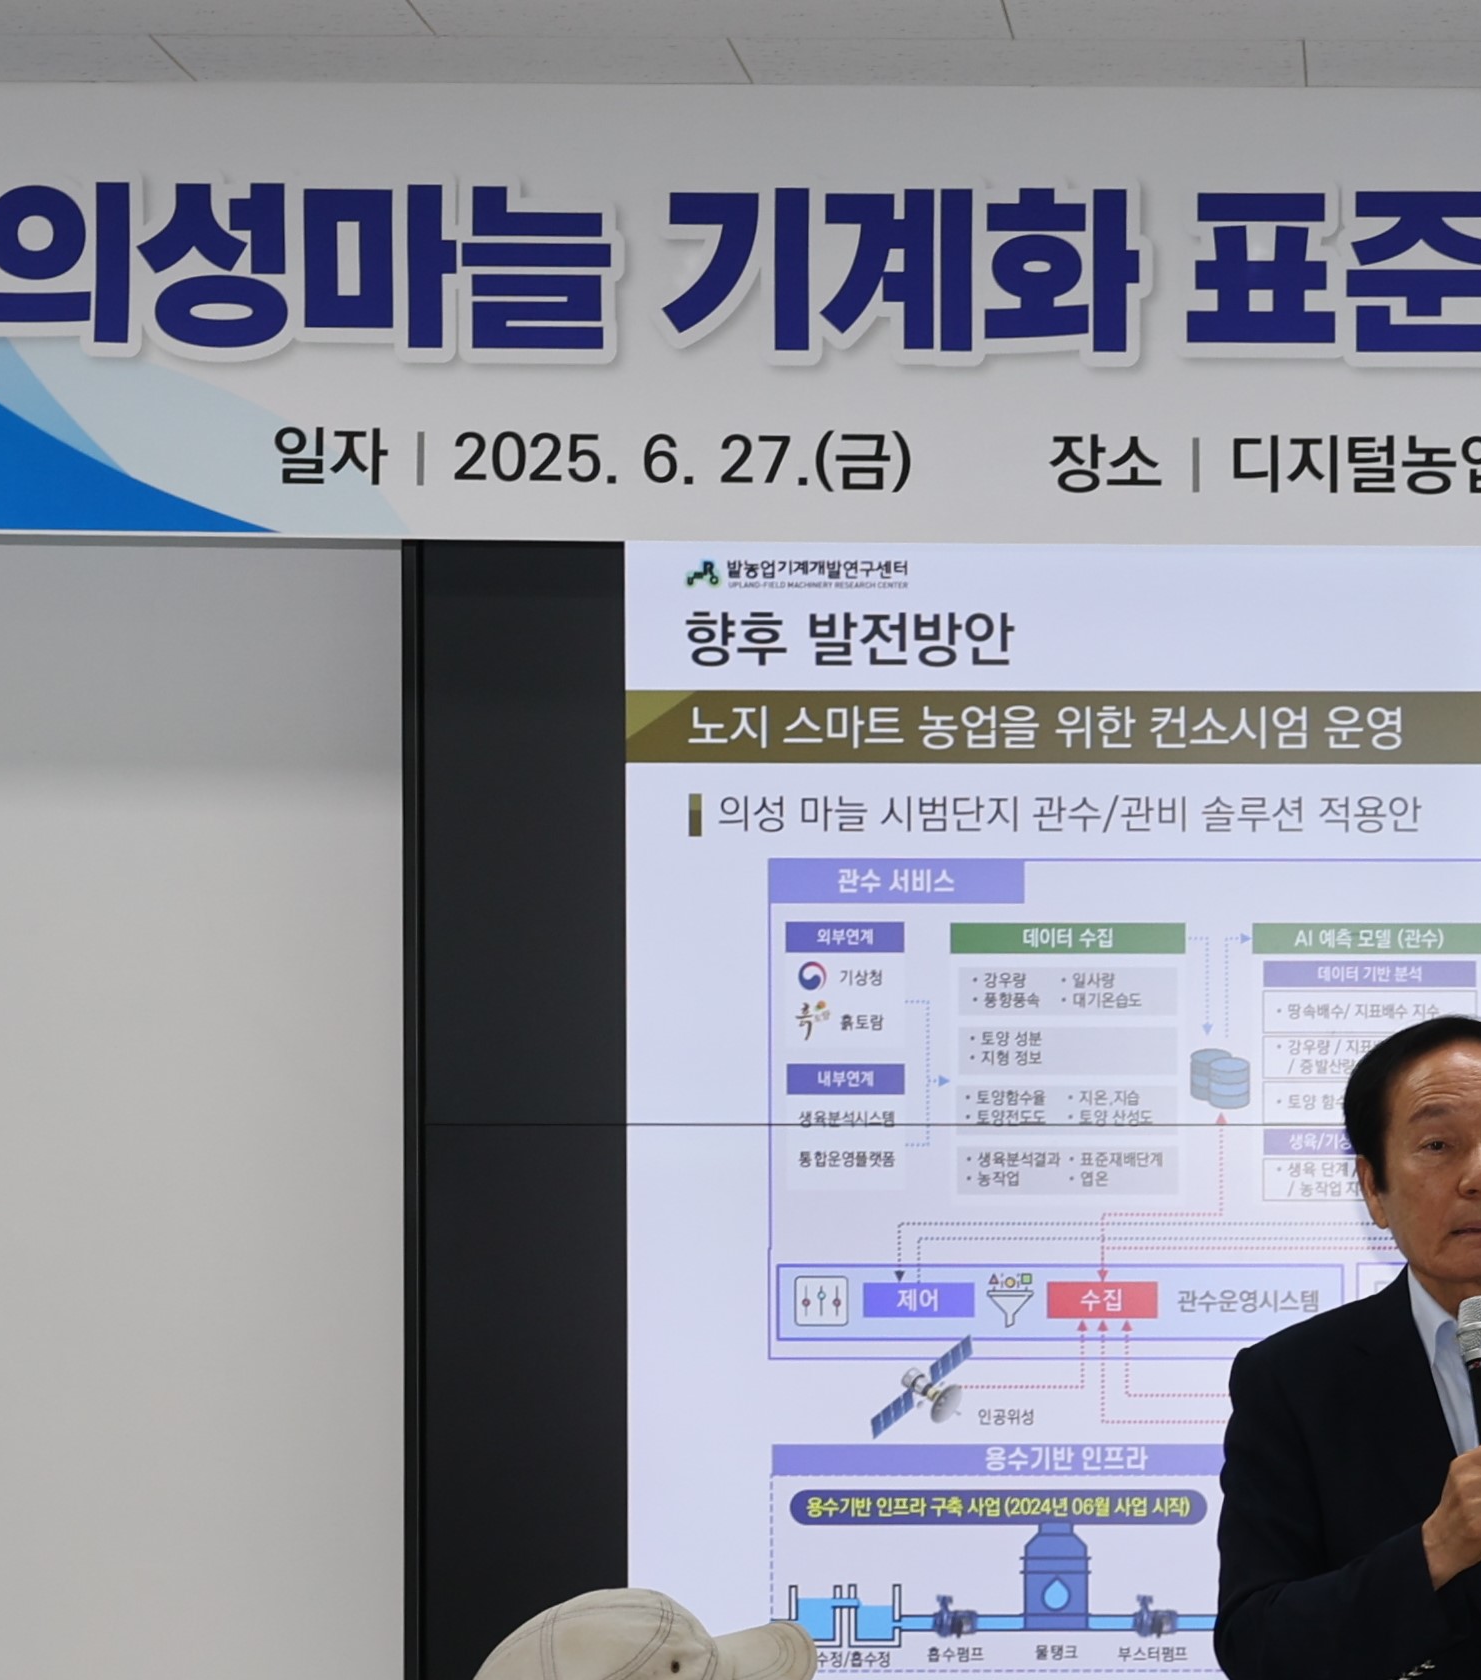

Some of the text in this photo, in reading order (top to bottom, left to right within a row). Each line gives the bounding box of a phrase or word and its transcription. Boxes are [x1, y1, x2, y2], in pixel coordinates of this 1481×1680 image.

[662, 184, 1139, 355] 기계화
[274, 424, 912, 495] 일자 2025. 6. 27.(금)
[1048, 428, 1163, 494] 장소
[727, 560, 908, 579] 밭농업기계개발연구센터
[686, 612, 1015, 667] 향후 발전방안
[688, 704, 1404, 750] 노지 스마트 농업을 위한 컨소시엄 운영
[718, 794, 1420, 834] 의성 마늘 시범단지 관수/관비 솔루션 적용안
[838, 868, 955, 894] 관수 서비스
[817, 928, 873, 946] 외부연계
[1023, 928, 1113, 948] 데이터 수집
[1295, 928, 1444, 950] AI 예측 모델 (관수)
[840, 970, 882, 986] 기상청
[984, 973, 1115, 988] 강우량 일사량
[1318, 966, 1422, 982] 데이터 기반 분석
[1355, 1004, 1407, 1019] 지표배수
[981, 1031, 1042, 1046] 토양 성분
[1288, 1040, 1330, 1054] 강우량
[981, 1051, 1042, 1066] 지형 정보
[818, 1070, 874, 1087] 내부연계
[1288, 1095, 1316, 1110] 토양
[799, 1151, 895, 1168] 통합운영플랫폼
[978, 1151, 1163, 1168] 생육분석결과 표준재배단계
[978, 1171, 1019, 1187] 농작업
[896, 1290, 939, 1311] 제어
[1080, 1289, 1122, 1312] 수집
[1178, 1290, 1319, 1313] 관수운영시스템
[978, 1409, 1034, 1426] 인공위성
[985, 1446, 1148, 1472] 용수기반 인프라
[806, 1497, 1190, 1517] 용수기반 인프라 구축 사업 (2024년 06월 사업 시작)
[817, 1650, 890, 1668] 수정/흡수정
[928, 1646, 984, 1662] 흡수펌프
[1035, 1644, 1078, 1660] 물탱크
[1118, 1645, 1188, 1661] 부스터펌프
